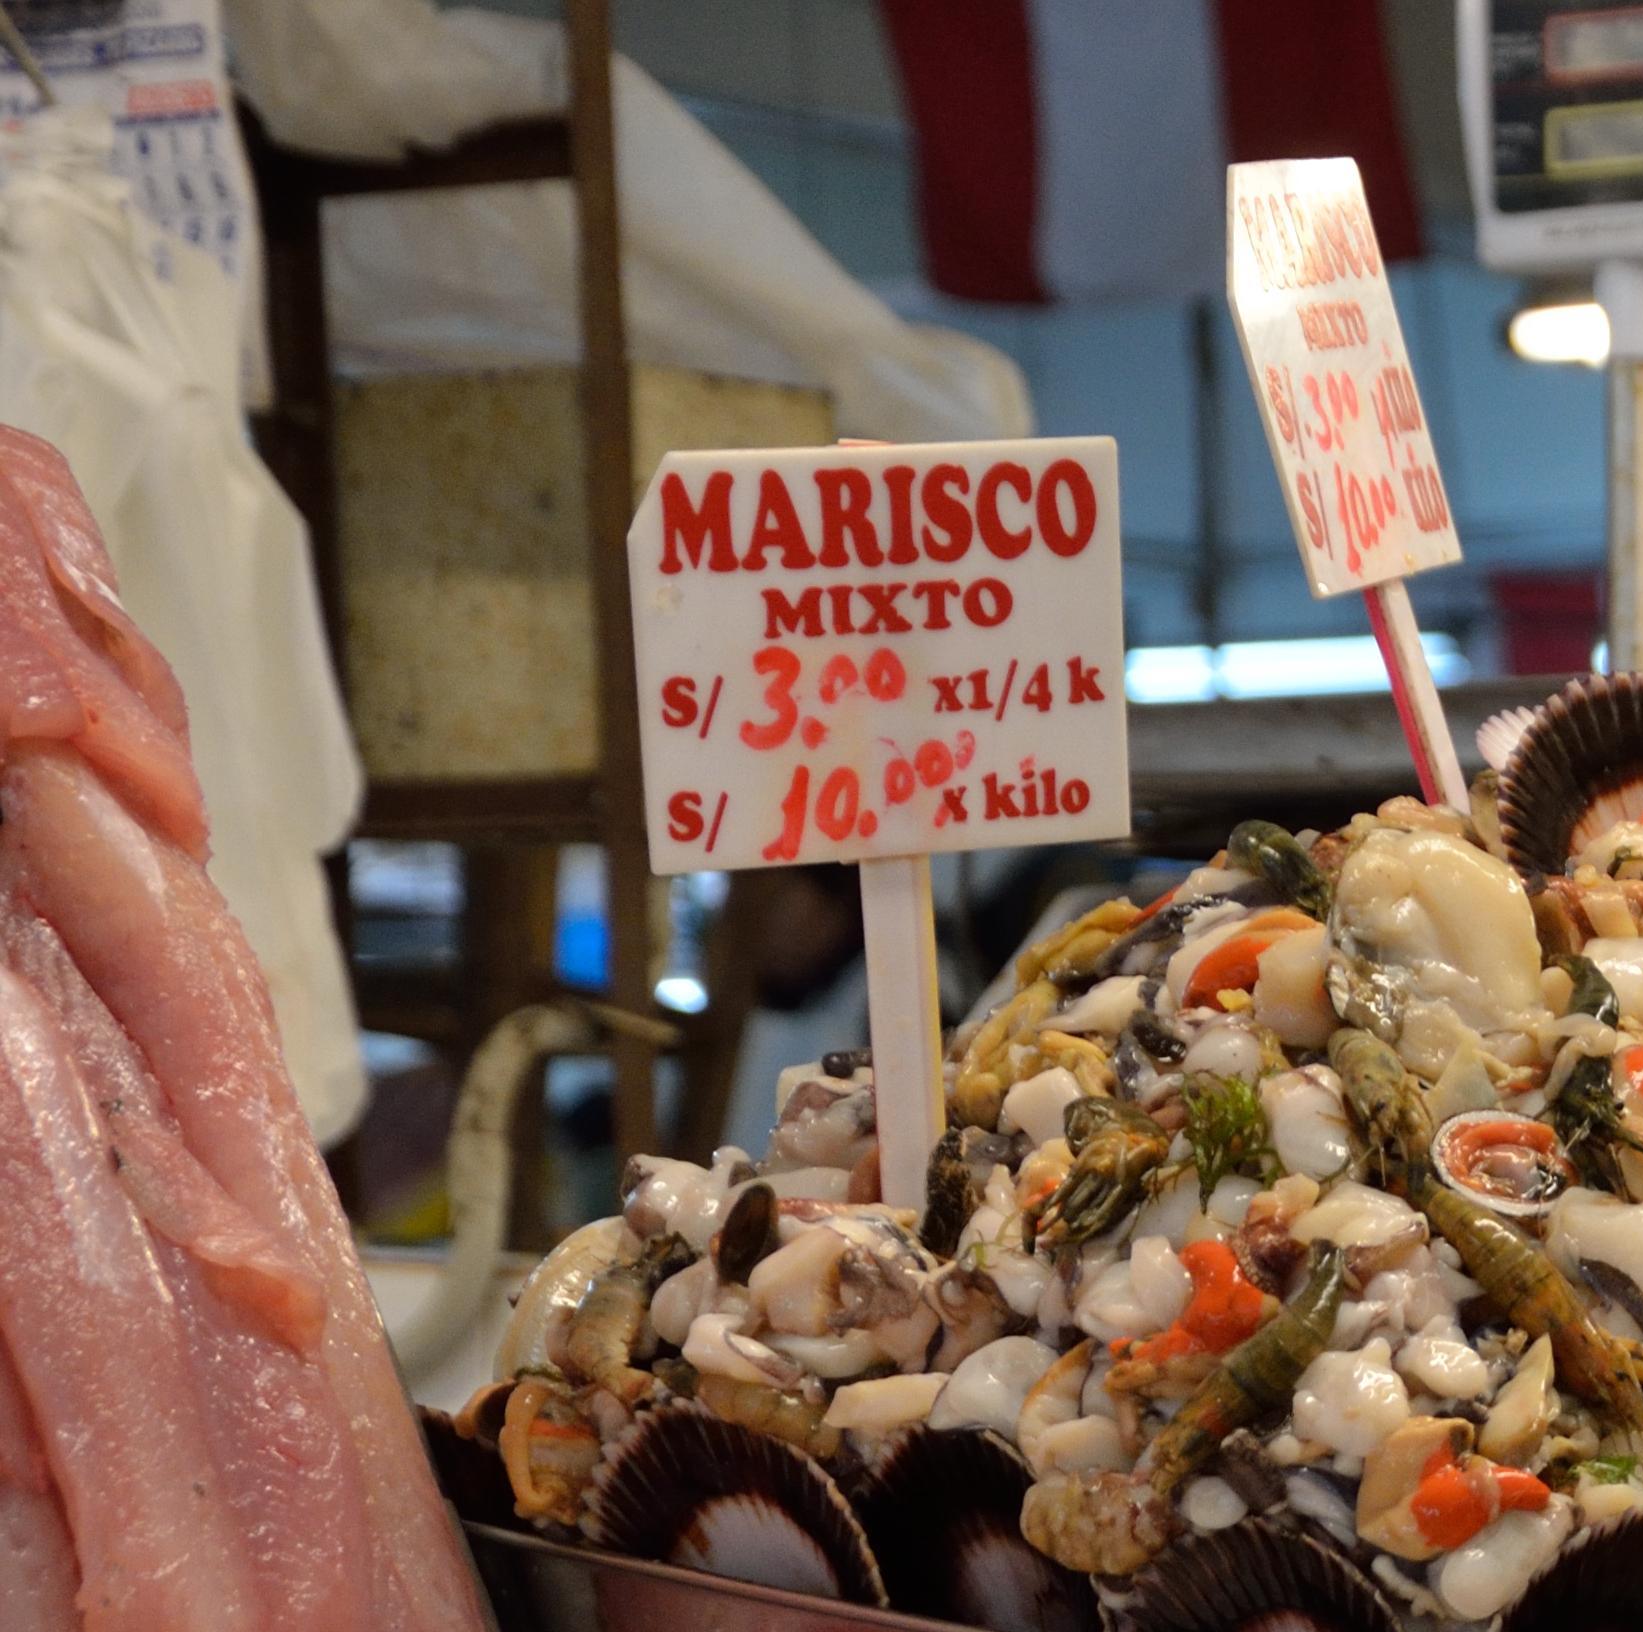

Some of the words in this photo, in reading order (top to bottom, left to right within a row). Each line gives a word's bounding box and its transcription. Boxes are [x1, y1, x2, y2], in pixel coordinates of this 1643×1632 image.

[659, 458, 1097, 574] MARISCO
[761, 577, 1013, 638] MIXTO
[661, 675, 723, 739] S/
[667, 792, 728, 853] S/
